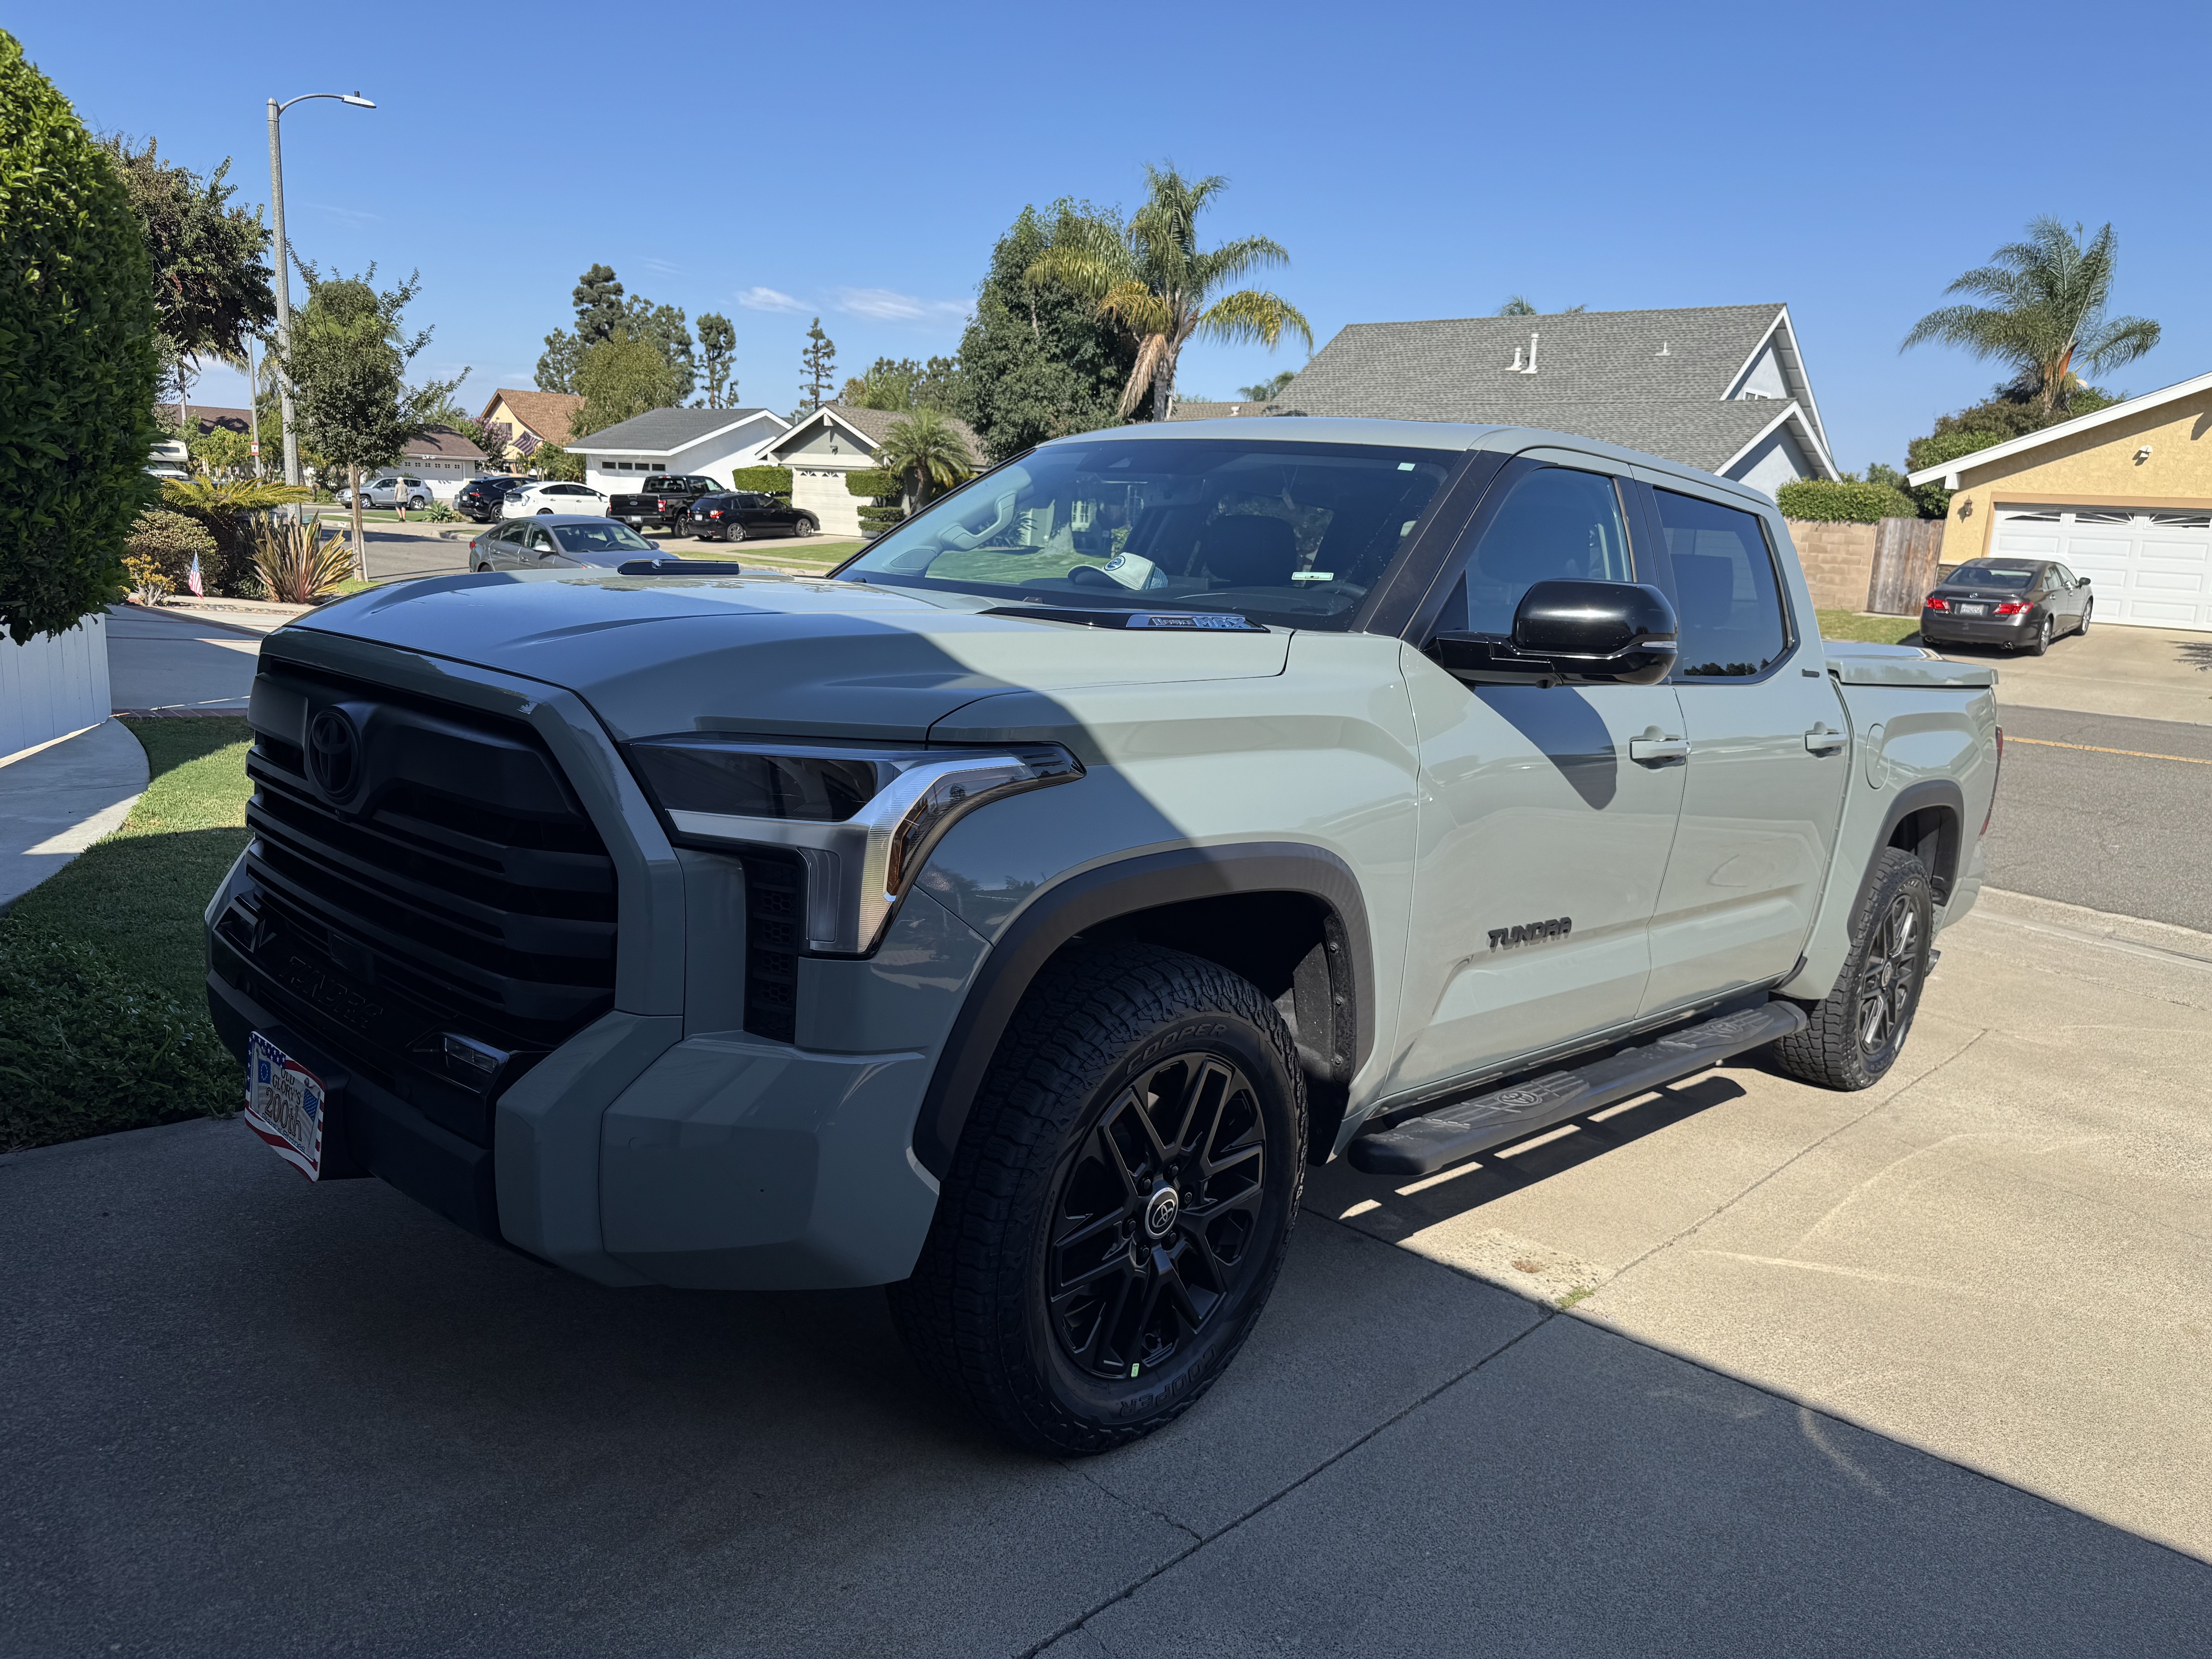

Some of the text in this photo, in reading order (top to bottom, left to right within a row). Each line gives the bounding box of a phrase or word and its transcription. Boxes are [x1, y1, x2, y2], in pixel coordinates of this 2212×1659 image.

[1193, 617, 1251, 628] MAX
[1488, 917, 1571, 948] TUNDRA
[279, 955, 383, 1029] TUNDRA
[1127, 1022, 1229, 1075] COOPER
[273, 1074, 301, 1105] GLORY'S
[281, 1067, 295, 1085] OLD
[265, 1087, 302, 1141] 200th
[1120, 1343, 1217, 1416] COOPER
